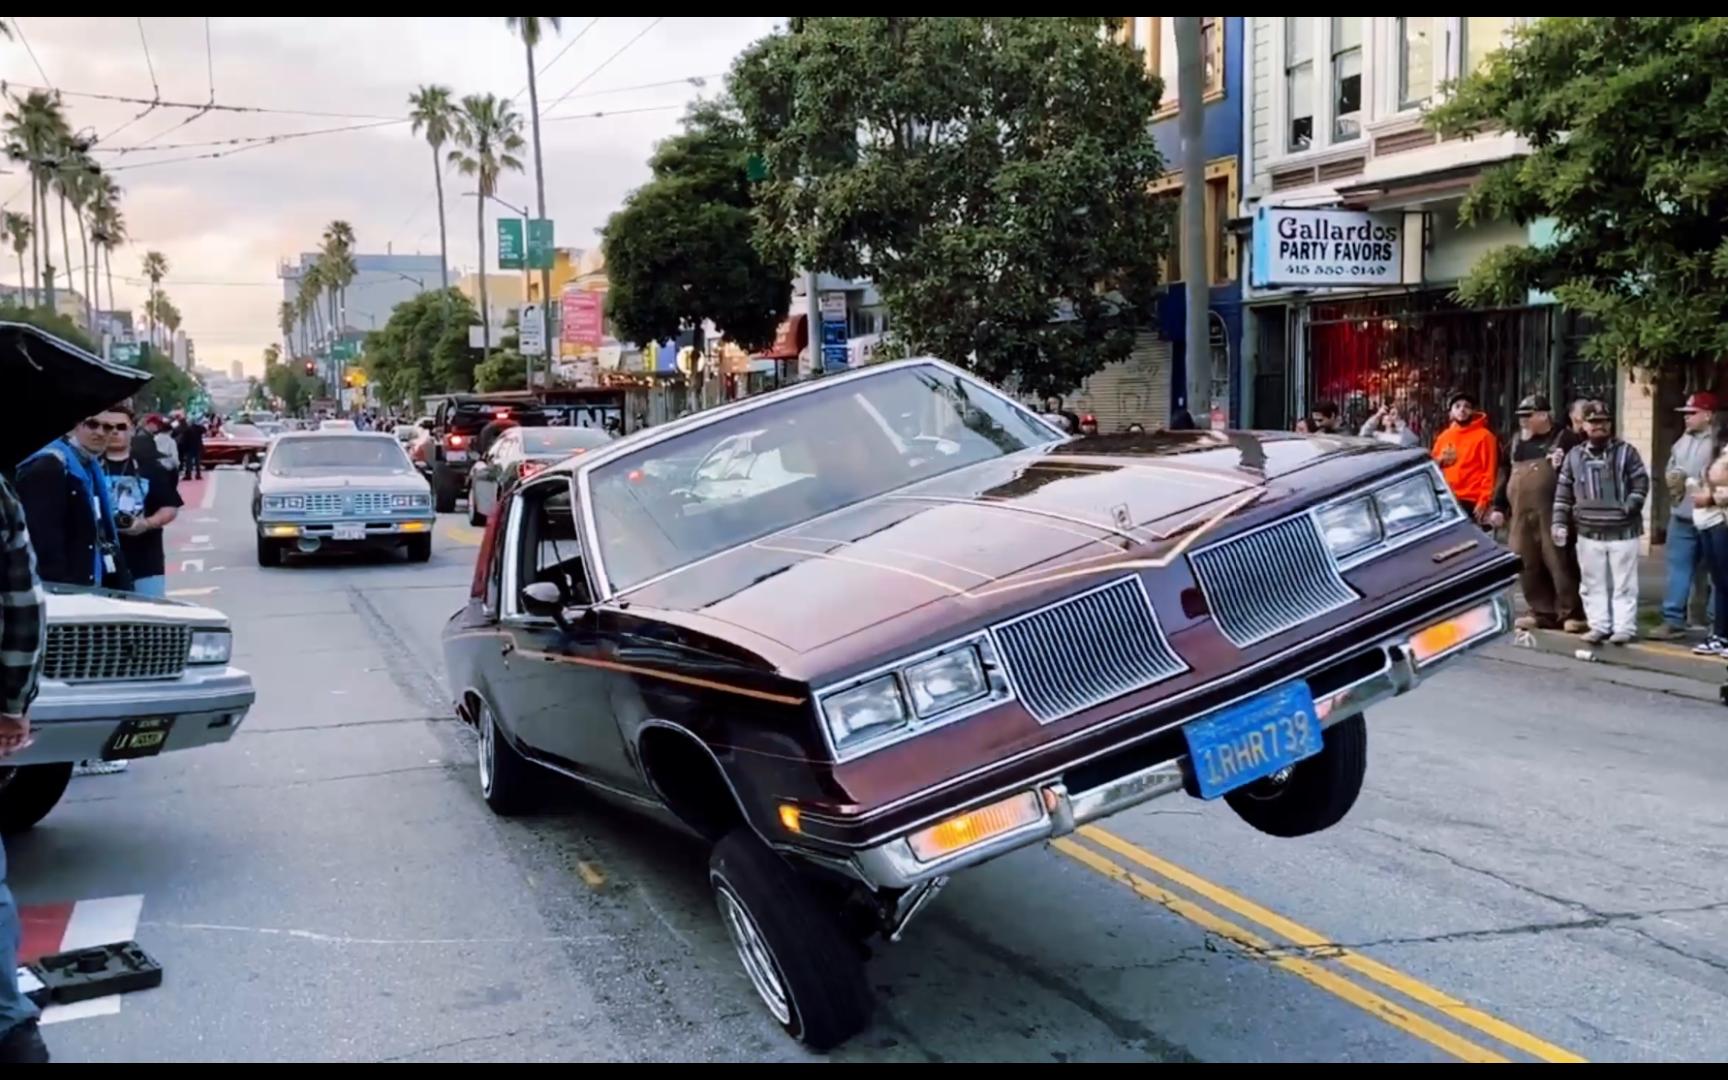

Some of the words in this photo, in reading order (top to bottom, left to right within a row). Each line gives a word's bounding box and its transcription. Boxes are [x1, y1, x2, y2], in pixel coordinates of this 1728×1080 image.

[1278, 217, 1397, 242] Gallardos
[1280, 241, 1329, 260] PARTY
[1334, 242, 1392, 261] FAVORS
[1286, 265, 1310, 275] 415
